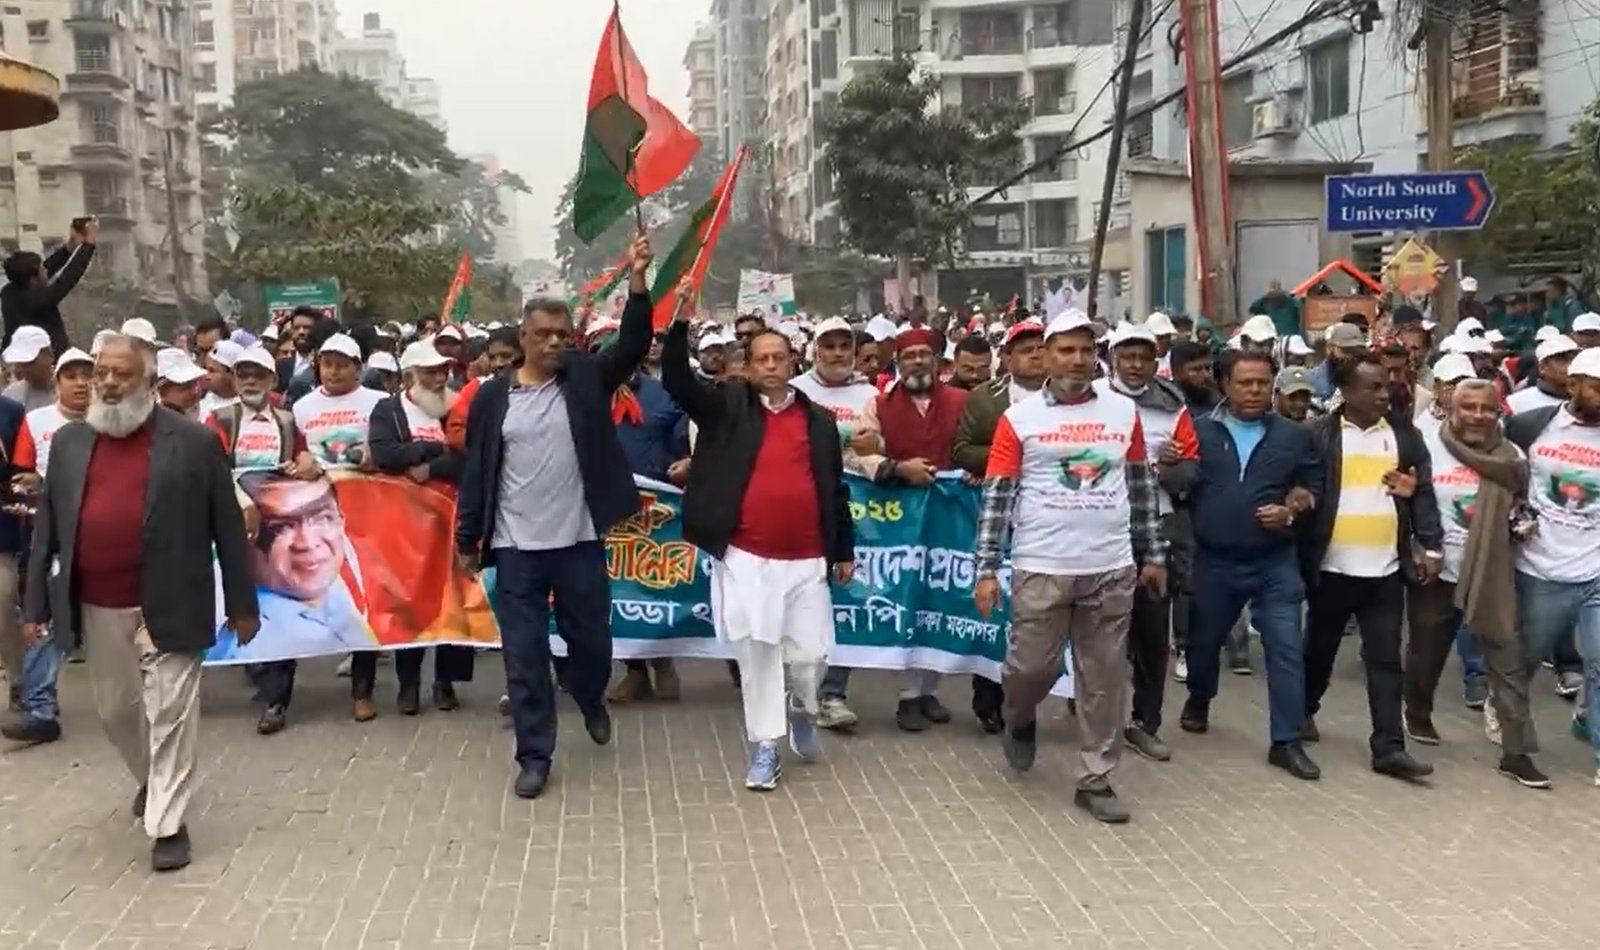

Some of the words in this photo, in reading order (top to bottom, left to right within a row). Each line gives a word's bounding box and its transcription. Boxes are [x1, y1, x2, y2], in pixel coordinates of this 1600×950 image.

[1341, 182, 1396, 199] North
[1402, 180, 1457, 196] South
[1341, 203, 1438, 222] University
